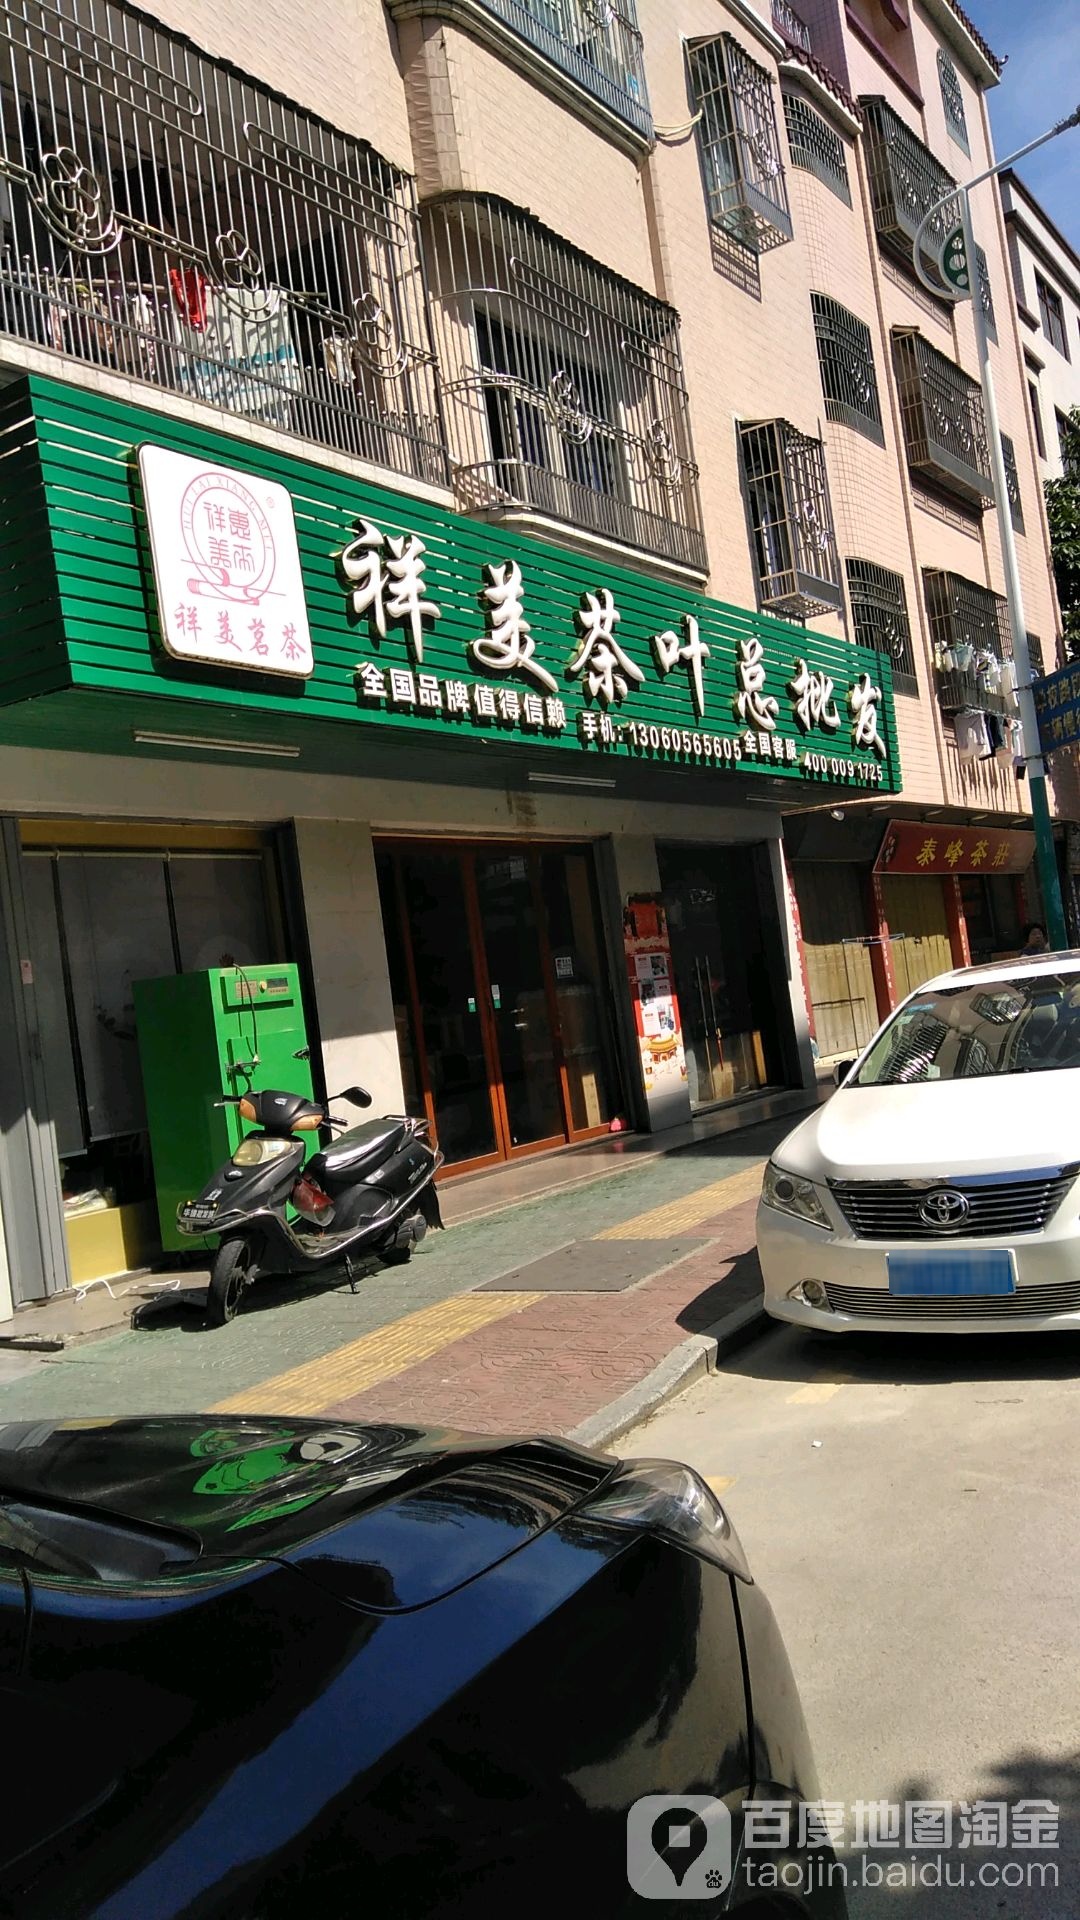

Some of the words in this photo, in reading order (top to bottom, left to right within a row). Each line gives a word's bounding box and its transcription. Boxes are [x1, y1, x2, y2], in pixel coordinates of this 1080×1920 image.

[174, 602, 306, 661] 祥美茗茶
[342, 519, 887, 759] 祥美茶叶总批发
[360, 663, 567, 729] 全国品牌值得信赖
[804, 751, 828, 773] 400
[832, 757, 855, 777] 009
[858, 761, 883, 782] 1725
